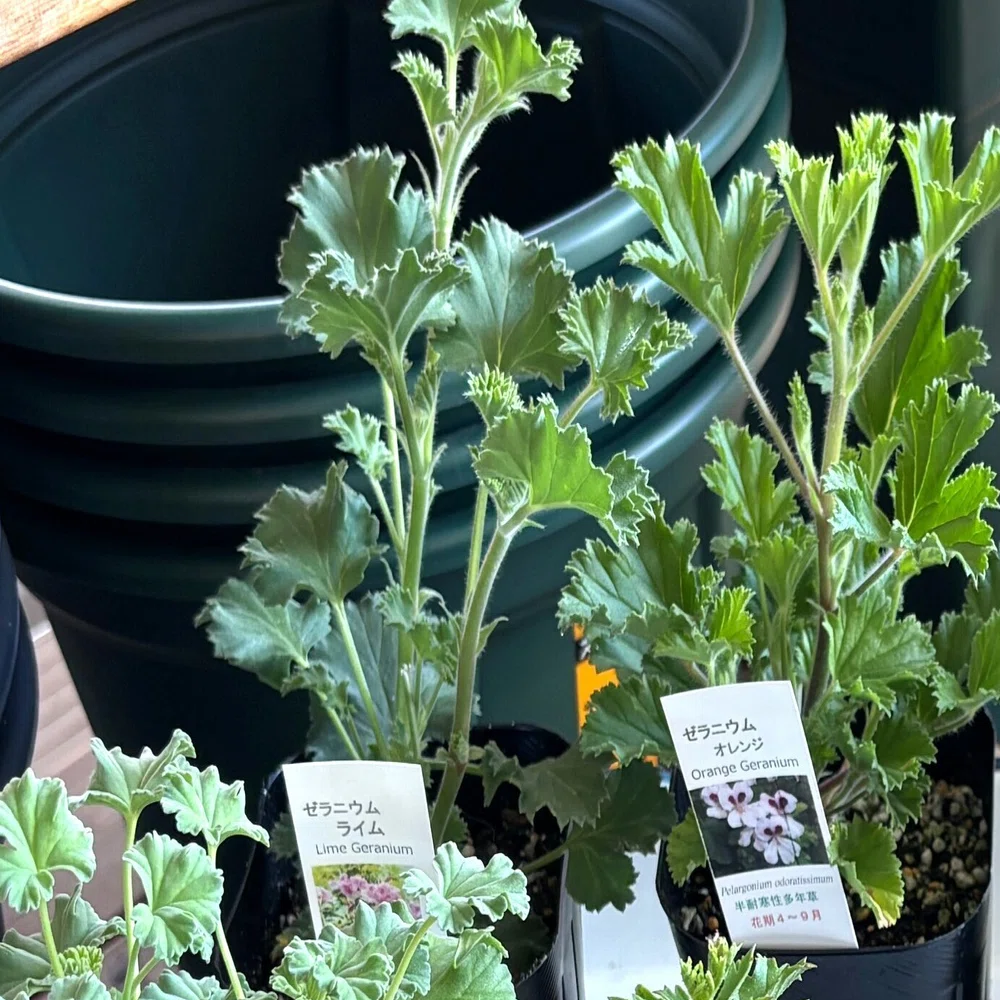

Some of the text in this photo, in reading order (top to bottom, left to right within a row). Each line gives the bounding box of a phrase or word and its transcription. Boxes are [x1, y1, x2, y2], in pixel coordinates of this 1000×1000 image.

[683, 717, 757, 742] ゼラニウム
[713, 737, 765, 757] オレンジ
[691, 756, 800, 781] Orange Geranium
[302, 800, 381, 818] ゼラニウム
[336, 820, 386, 838] ライム
[315, 842, 414, 856] Lime Geranium
[720, 874, 834, 897] Pelargonium odoratissimum
[734, 891, 819, 913] 半耐寒性多年草
